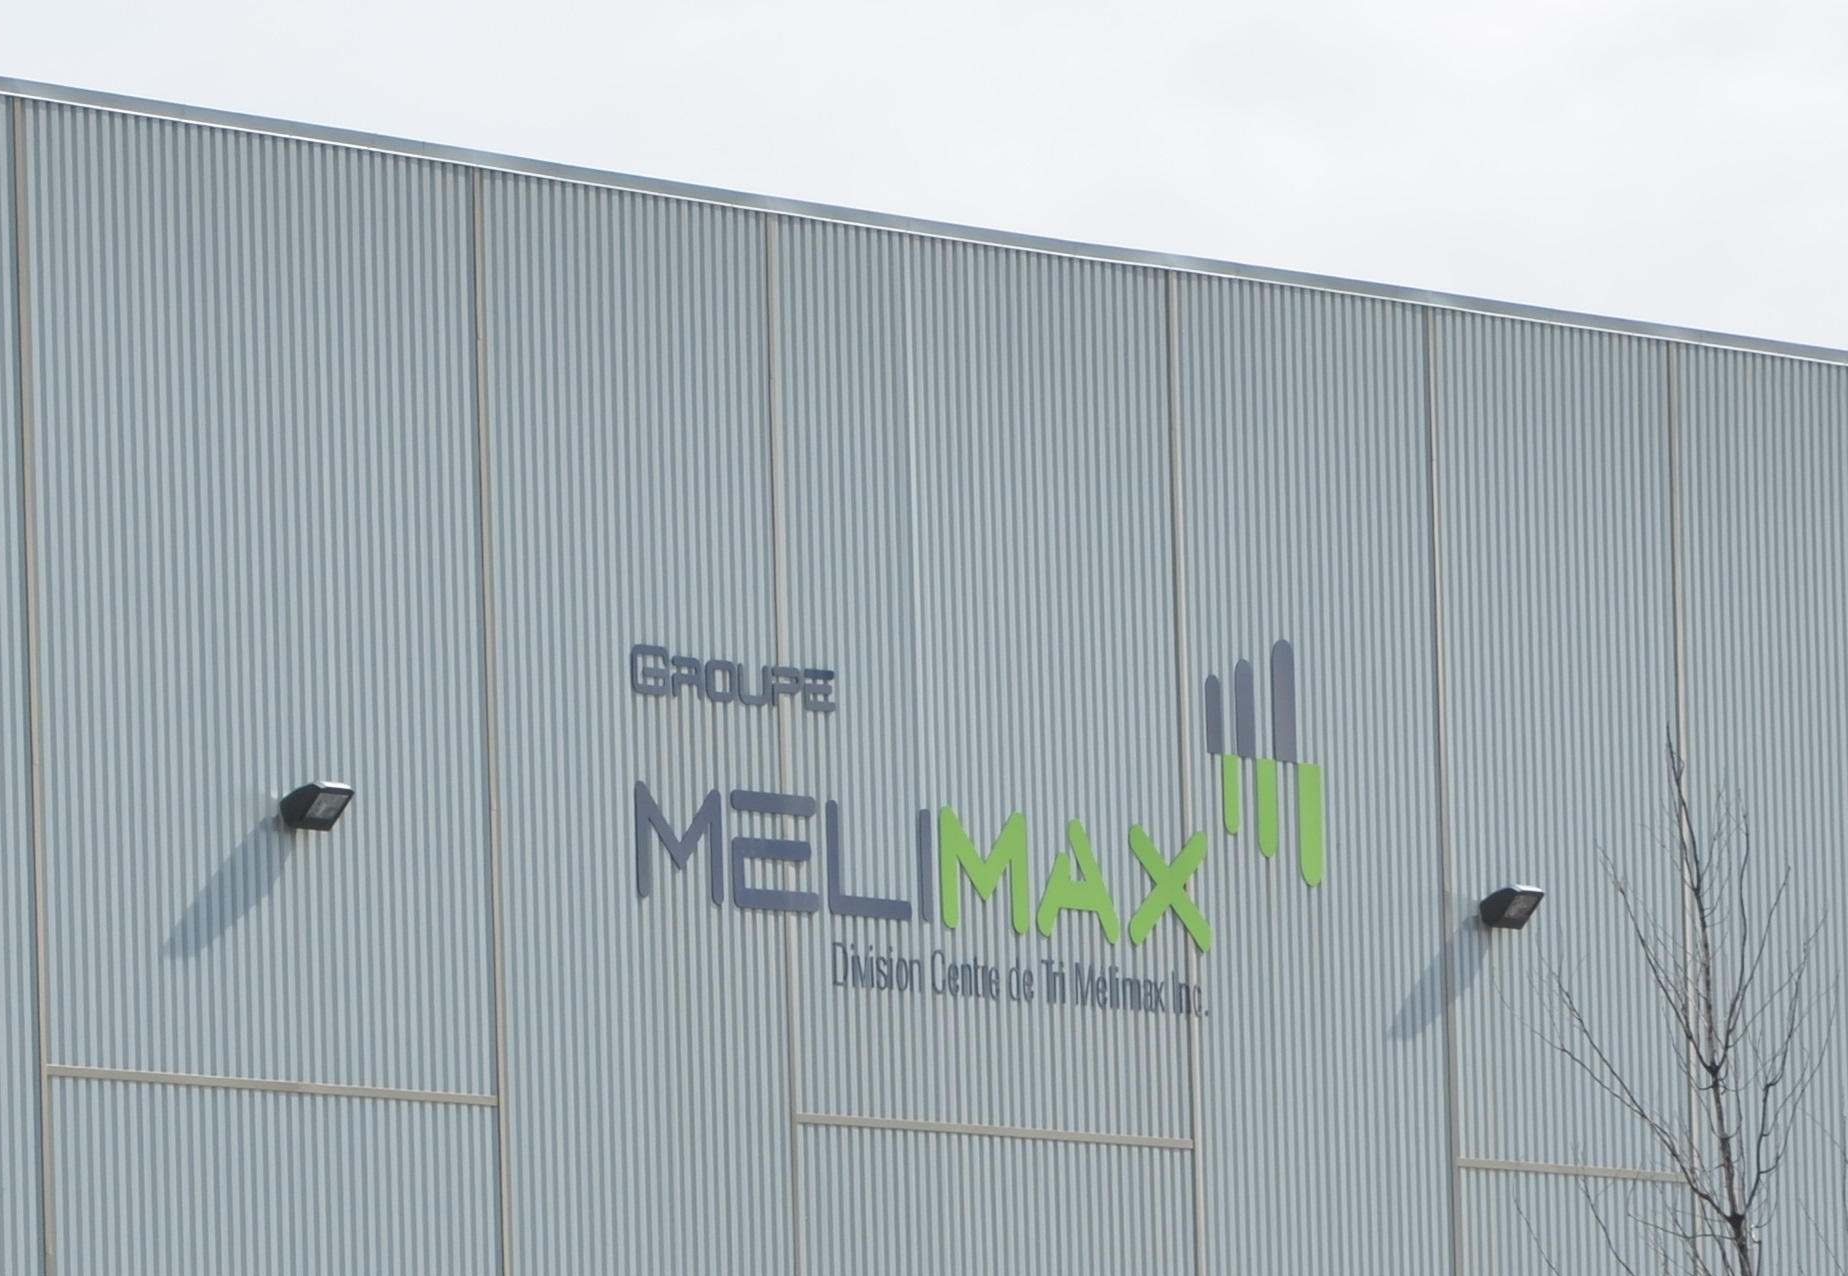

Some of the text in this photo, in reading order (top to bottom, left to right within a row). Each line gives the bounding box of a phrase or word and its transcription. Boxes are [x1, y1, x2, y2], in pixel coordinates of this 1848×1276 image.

[630, 643, 837, 713] GROUPE
[634, 780, 1212, 953] MELIMAX
[831, 941, 1210, 1020] Division Centre de Tri Mélimax Inc.
